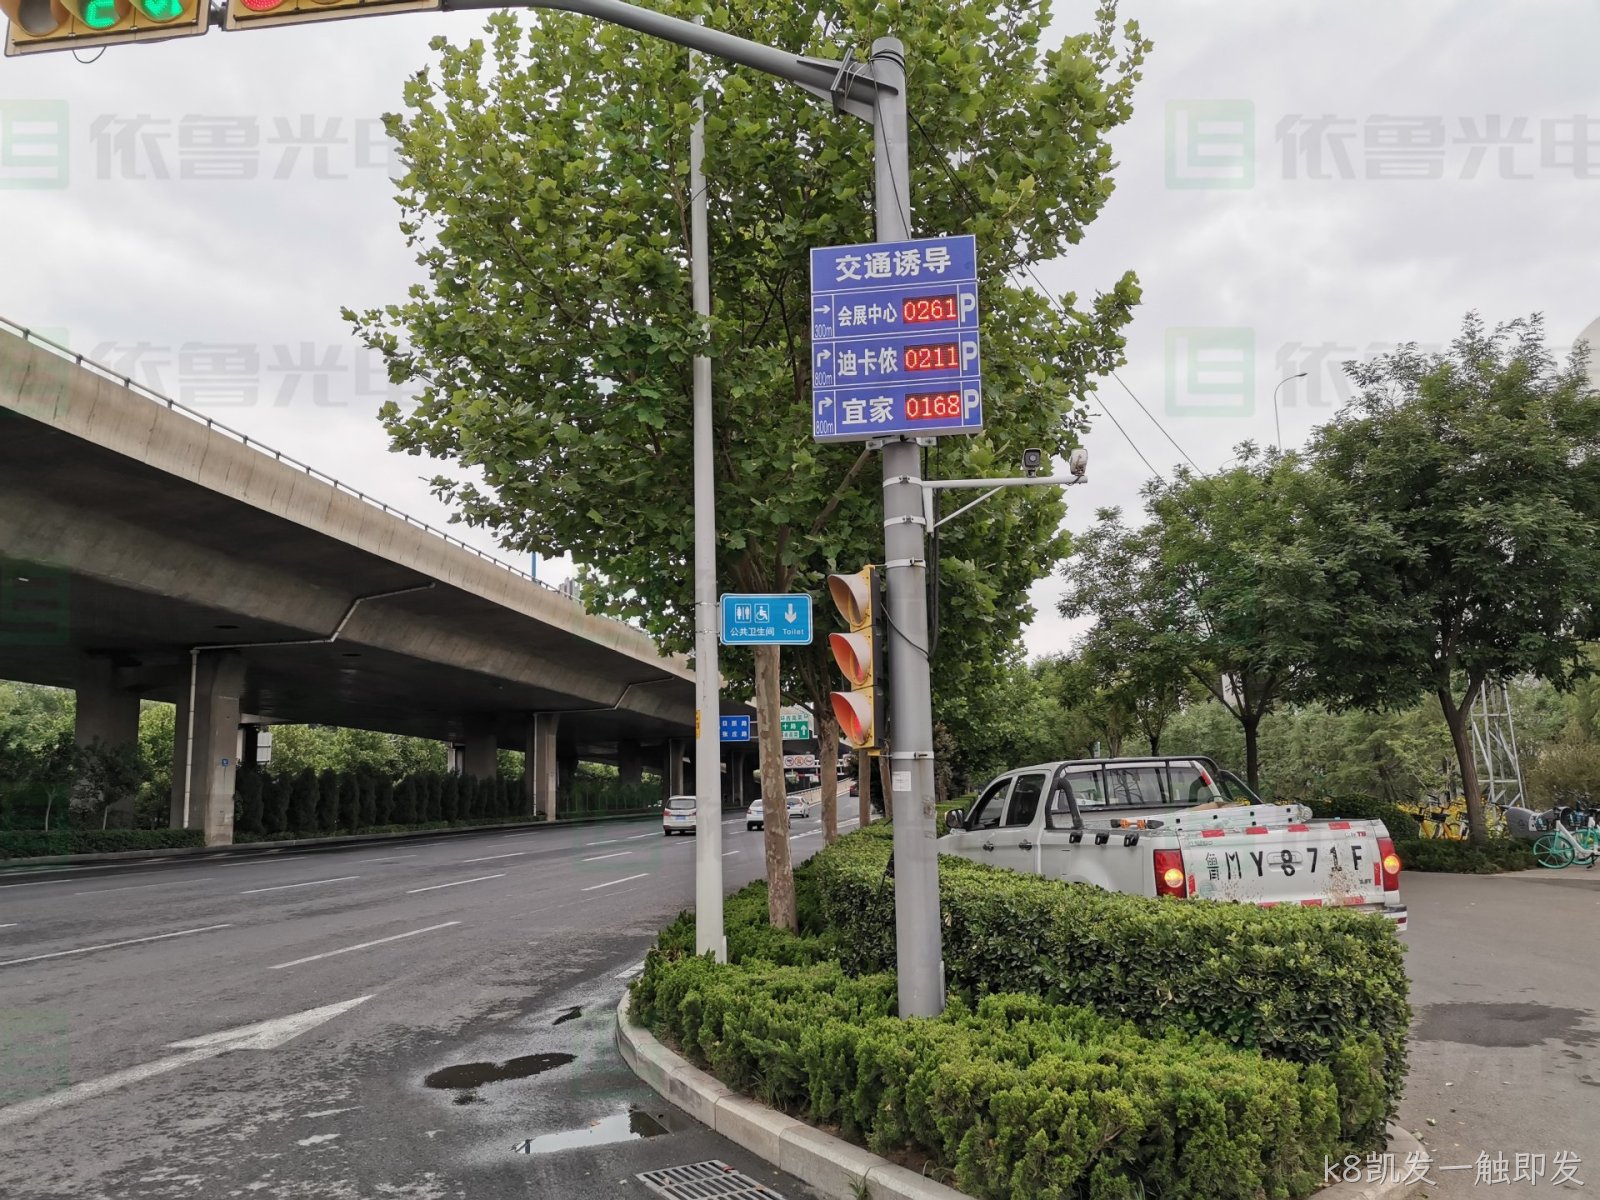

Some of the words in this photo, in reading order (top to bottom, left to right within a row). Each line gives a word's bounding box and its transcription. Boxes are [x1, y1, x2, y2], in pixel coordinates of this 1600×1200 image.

[835, 246, 952, 282] 交通诱导
[837, 302, 898, 328] 会展中心
[904, 298, 957, 321] 0261
[960, 292, 976, 323] P
[814, 324, 833, 338] 300m
[837, 346, 899, 377] 迪卡侬
[905, 346, 959, 369] 0211
[962, 340, 978, 371] P
[814, 374, 833, 386] 800m
[841, 395, 895, 425] 宜家
[906, 394, 961, 417] 0168
[964, 388, 980, 420] P
[816, 421, 834, 434] 800m
[730, 627, 775, 637] 公共卫生间
[782, 628, 804, 636] Toilet
